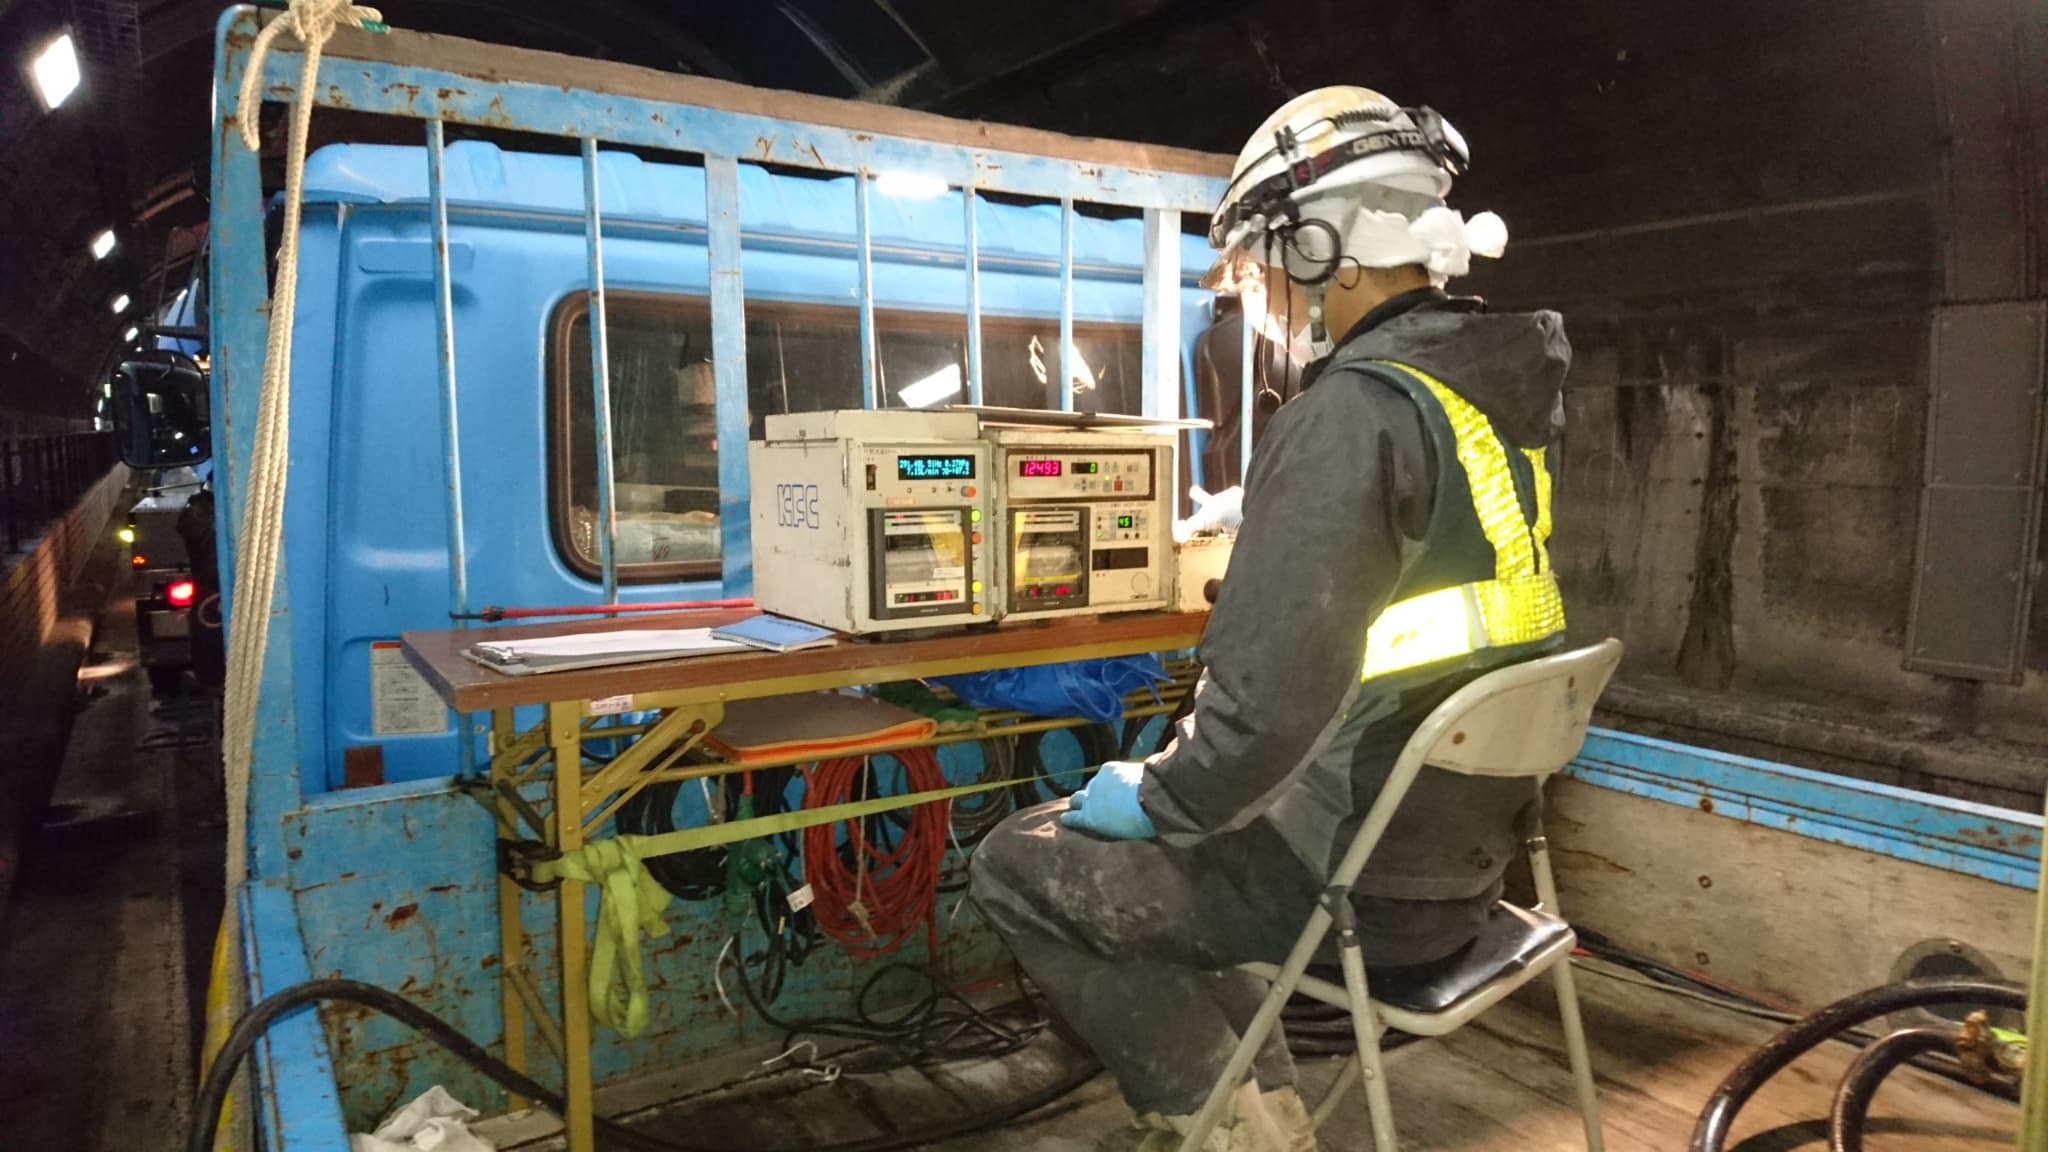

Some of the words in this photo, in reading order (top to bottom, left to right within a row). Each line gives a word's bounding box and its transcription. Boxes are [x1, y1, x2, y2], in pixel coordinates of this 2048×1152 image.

[1023, 462, 1060, 476] 12493
[1089, 463, 1096, 473] 0
[777, 484, 820, 529] KFC
